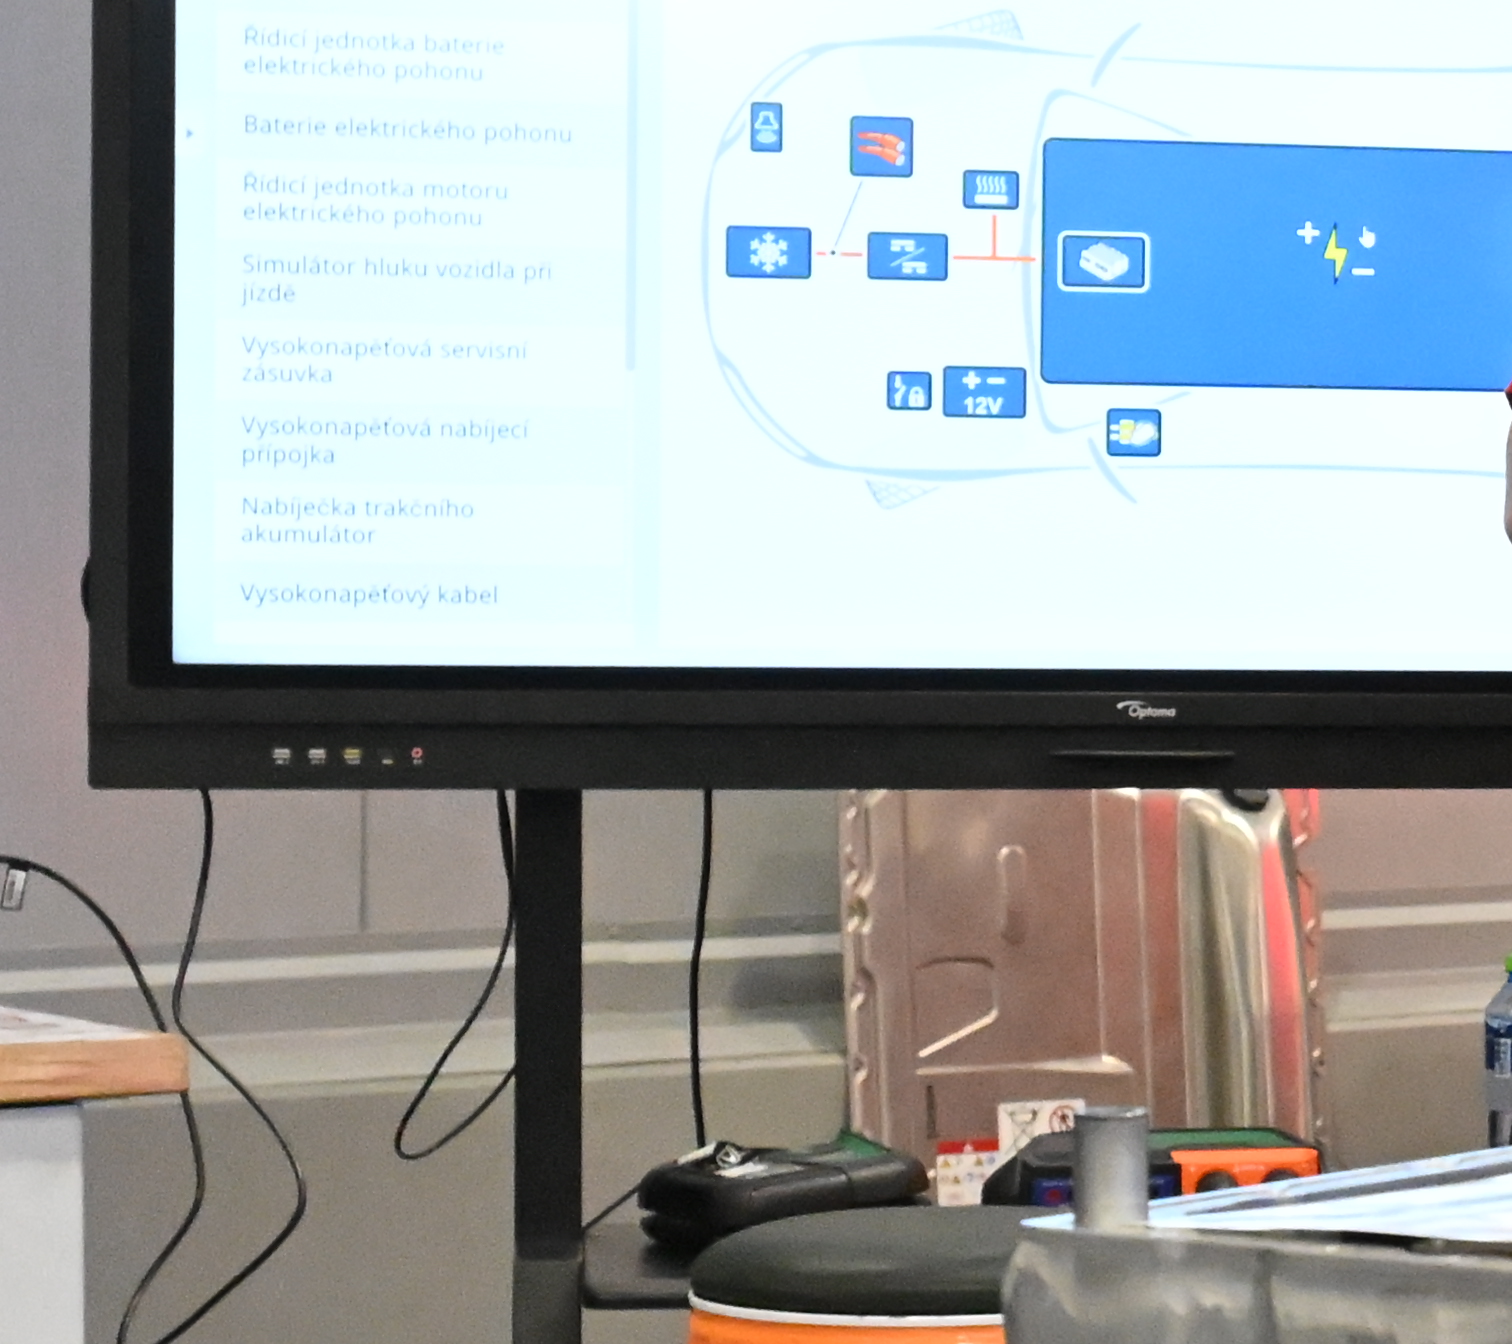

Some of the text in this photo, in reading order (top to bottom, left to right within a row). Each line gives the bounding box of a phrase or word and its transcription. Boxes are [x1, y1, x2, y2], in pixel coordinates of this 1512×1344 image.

[313, 30, 416, 55] jednotka
[424, 33, 506, 55] baterie
[243, 56, 484, 85] elektrického pohonu
[244, 114, 573, 146] Baterie elektrického pohonu
[313, 176, 415, 201] jednotka
[423, 181, 509, 201] motoru
[243, 202, 483, 231] elektrického pohonu
[241, 253, 553, 285] Simulátor hluku vozidla při
[240, 281, 297, 308] jízdě
[241, 335, 529, 362] Vysokonapěťová servisní
[241, 362, 334, 384] zásuvka
[963, 395, 1004, 415] 12V
[240, 414, 531, 444] Vysokonapěťová nabíjecí
[241, 443, 337, 470] přípojka
[241, 496, 476, 523] Nabíječka trakčního
[240, 523, 378, 546] akumulátor
[239, 582, 500, 611] Vysokonapěťový kabel
[1126, 704, 1177, 720] Optoma
